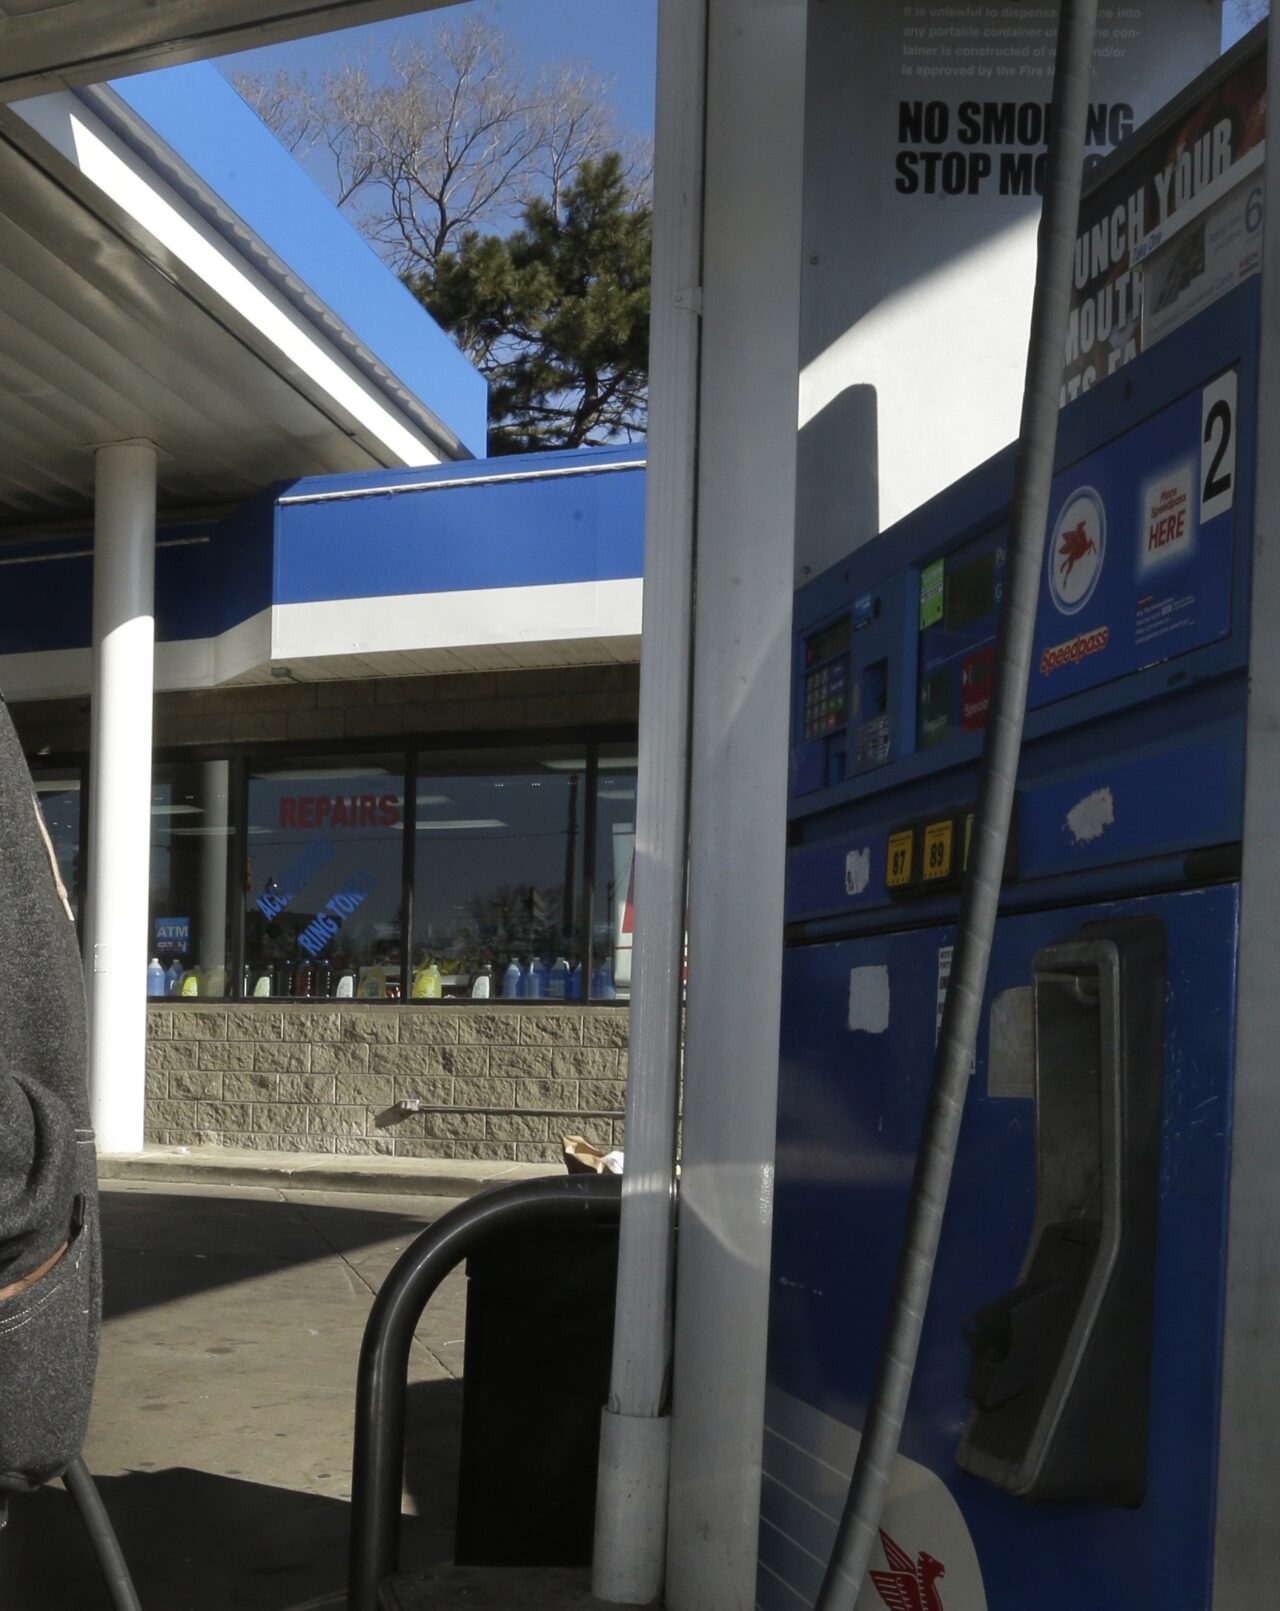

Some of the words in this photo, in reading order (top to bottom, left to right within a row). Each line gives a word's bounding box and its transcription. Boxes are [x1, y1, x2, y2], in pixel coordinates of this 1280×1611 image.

[903, 6, 912, 18] It
[914, 6, 926, 18] is
[929, 6, 982, 18] unlawful
[985, 7, 997, 18] to
[1001, 7, 1058, 20] dispense
[1116, 7, 1142, 18] into
[903, 28, 924, 39] any
[928, 25, 980, 39] portable
[983, 26, 1042, 38] container
[1113, 28, 1141, 39] con-
[902, 45, 938, 57] tainer
[940, 45, 952, 57] is
[955, 45, 1030, 57] constructed
[1033, 45, 1046, 57] of
[1093, 45, 1126, 57] nd/or
[902, 64, 913, 77] is
[916, 64, 974, 80] approved
[977, 64, 993, 79] by
[996, 64, 1016, 77] the
[1019, 65, 1043, 78] Fire
[898, 100, 949, 145] NO
[957, 101, 1135, 147] SMONG
[894, 150, 992, 195] STOP
[1154, 116, 1233, 222] YOUR
[1244, 187, 1263, 234] 6
[1132, 242, 1148, 263] Take
[1203, 398, 1232, 504] 2
[1148, 508, 1186, 552] HERE
[1041, 626, 1109, 676] Speedpass
[279, 793, 401, 830] REPAIRS
[891, 849, 907, 877] 87
[929, 841, 944, 869] 89
[156, 926, 188, 938] ATM
[297, 911, 339, 957] RING
